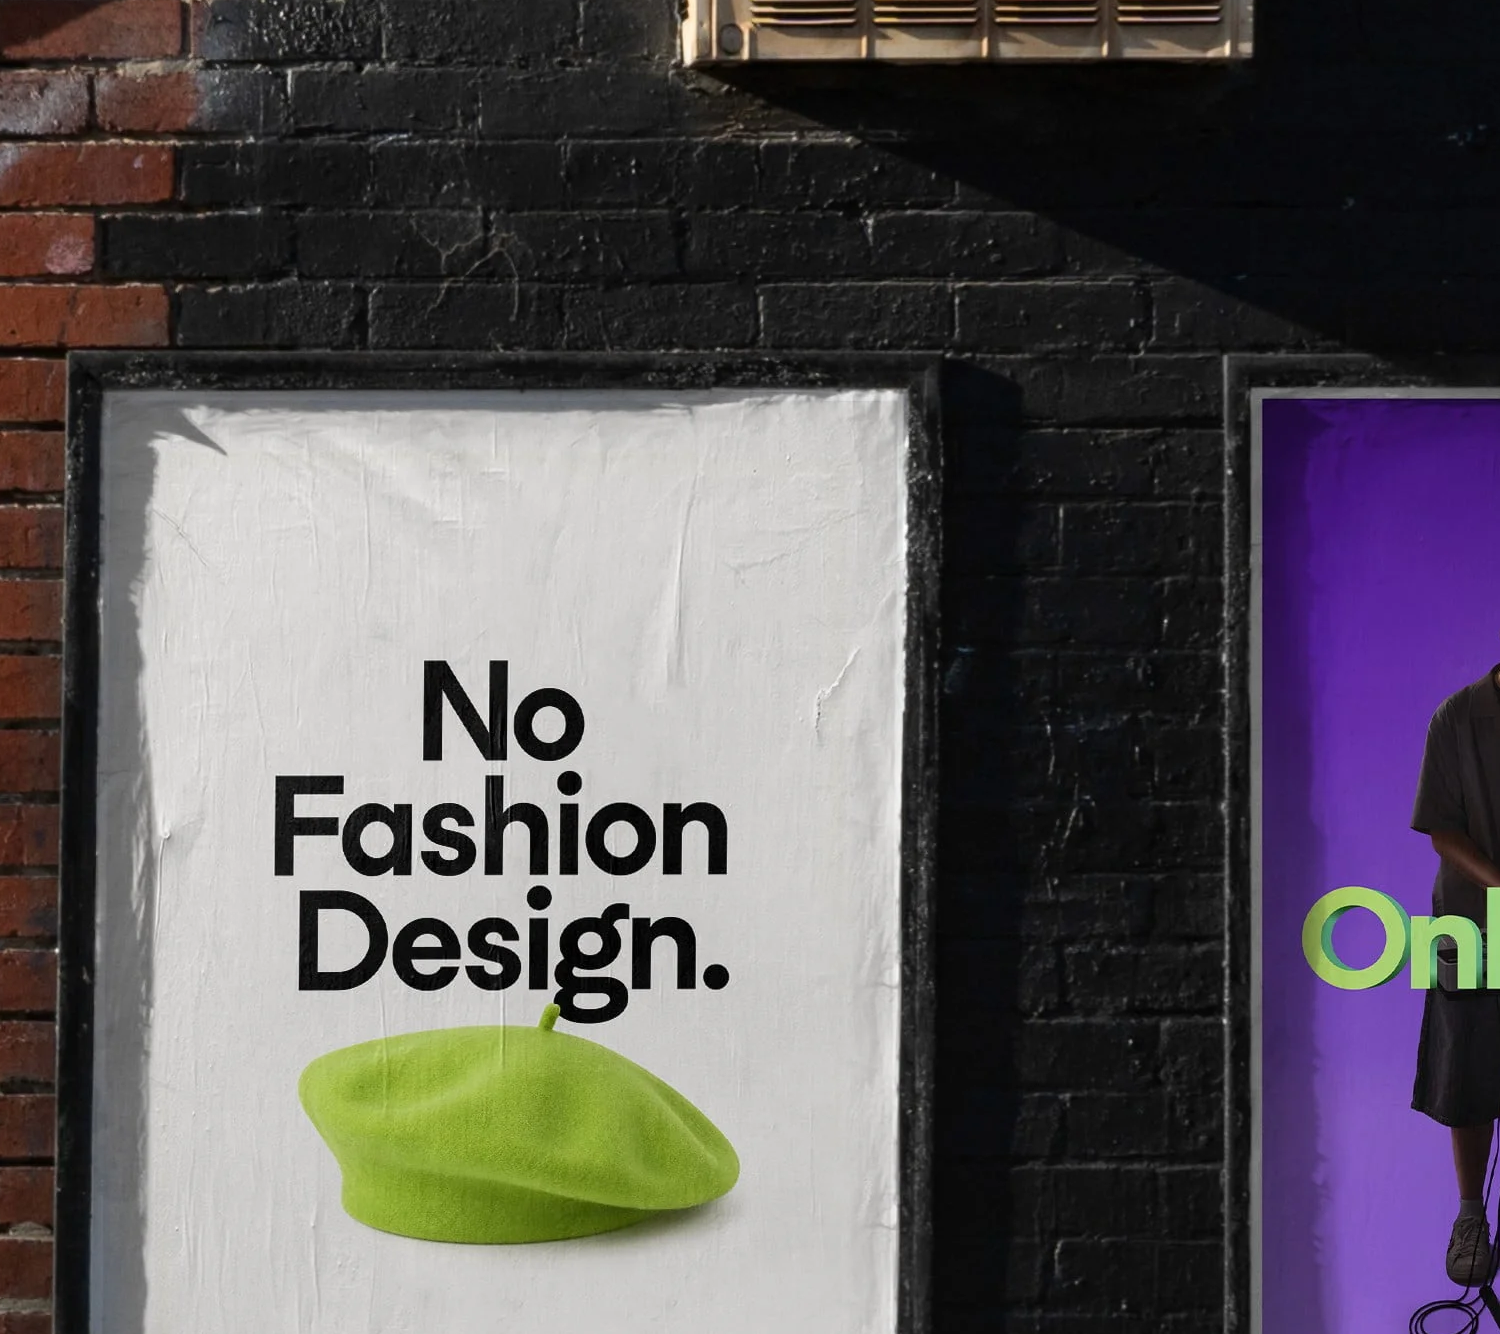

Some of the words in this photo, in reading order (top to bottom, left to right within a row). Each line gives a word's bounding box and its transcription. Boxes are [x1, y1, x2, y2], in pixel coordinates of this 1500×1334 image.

[422, 660, 585, 762] No
[274, 770, 728, 877] Fashion
[298, 885, 730, 1024] Design.
